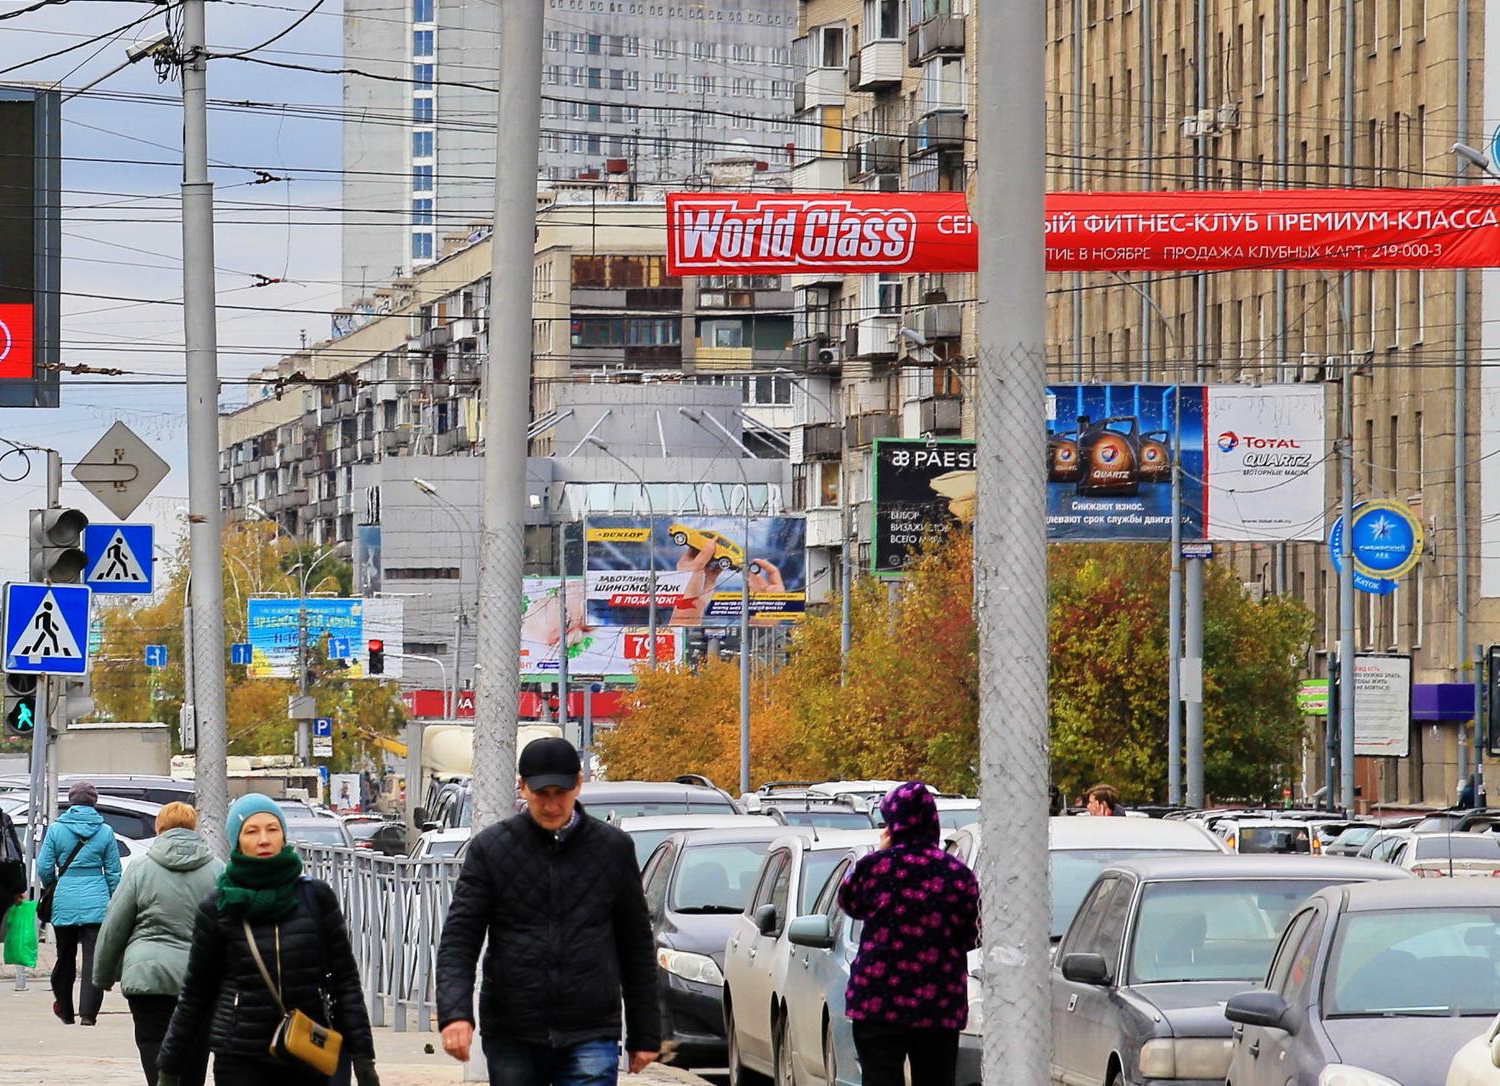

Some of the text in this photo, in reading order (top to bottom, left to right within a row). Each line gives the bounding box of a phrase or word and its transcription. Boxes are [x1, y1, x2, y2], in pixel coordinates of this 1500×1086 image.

[1084, 212, 1259, 233] ФИТНЕС-КЛУБ
[681, 208, 908, 259] World Class
[1080, 248, 1087, 260] В
[1093, 248, 1151, 260] НОЯБРЕ
[1164, 246, 1243, 261] ПРОДАЖА
[1248, 245, 1320, 259] КЛУБНЫХ
[1372, 243, 1442, 258] 219-000-3
[1243, 436, 1301, 448] TOTAL
[915, 451, 977, 467] PAES
[1243, 452, 1312, 467] QUARTZ
[1093, 470, 1130, 479] QUARTZ
[1071, 501, 1113, 510] Снижают
[1047, 515, 1081, 524] левают
[1083, 516, 1105, 524] срок
[1107, 514, 1142, 524] службы
[594, 584, 680, 592] ШИНОМОТАЖ
